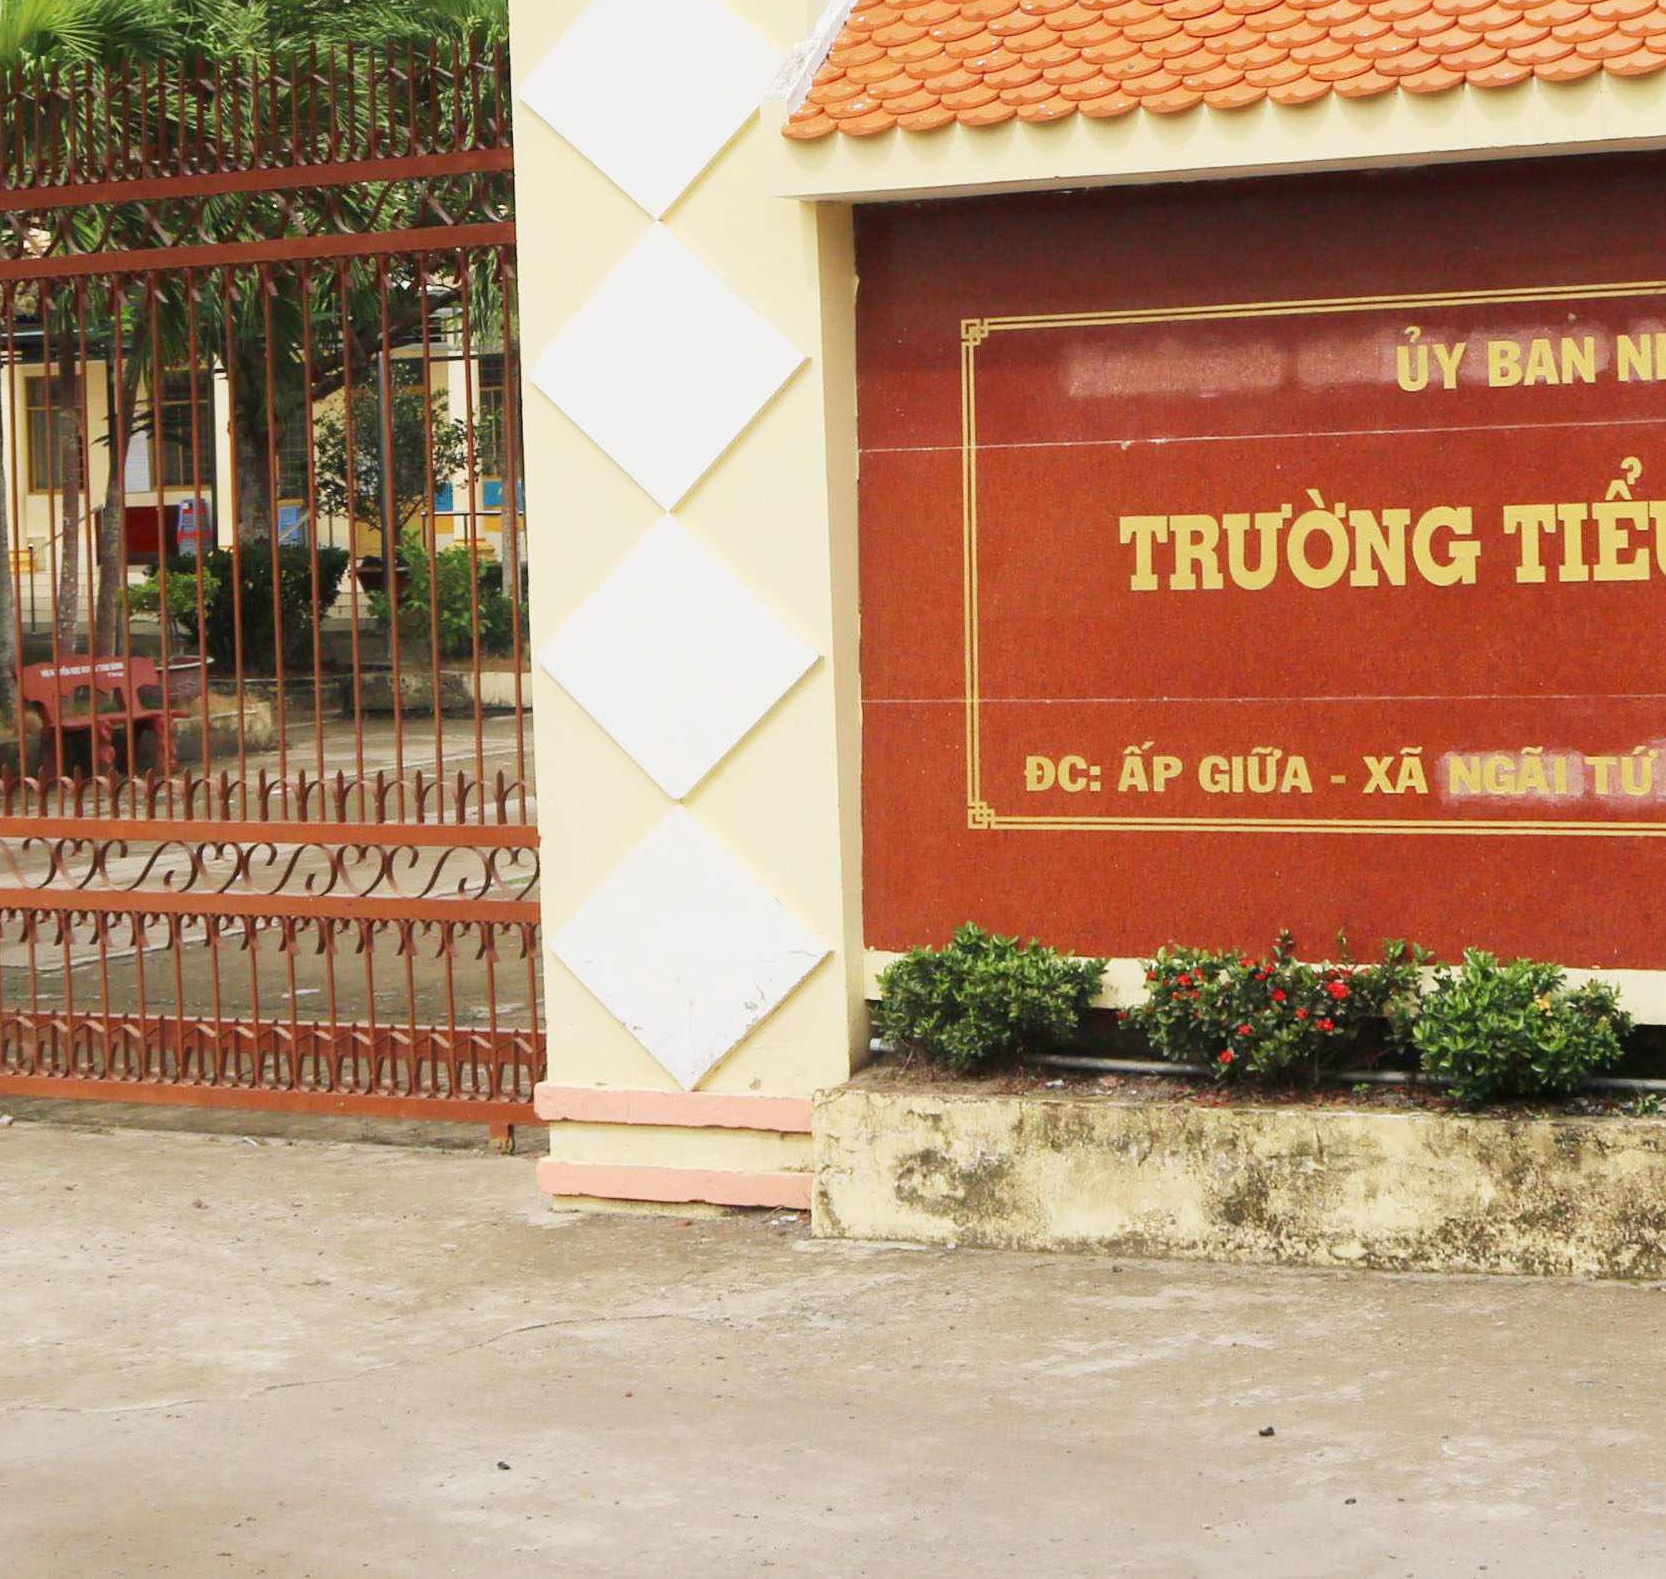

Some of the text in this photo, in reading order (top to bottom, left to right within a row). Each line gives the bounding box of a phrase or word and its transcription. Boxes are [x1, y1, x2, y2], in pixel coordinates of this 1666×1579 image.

[1396, 325, 1466, 391] ỦY
[1486, 335, 1597, 388] BAN
[1119, 488, 1481, 591] TRƯỜNG
[1024, 755, 1102, 792] ĐC:
[1117, 742, 1183, 792] ẤP
[1198, 746, 1313, 794] GIỮA
[1362, 746, 1429, 794] XÃ
[1448, 748, 1568, 795] NGÃI
[1583, 743, 1662, 796] TỨ
